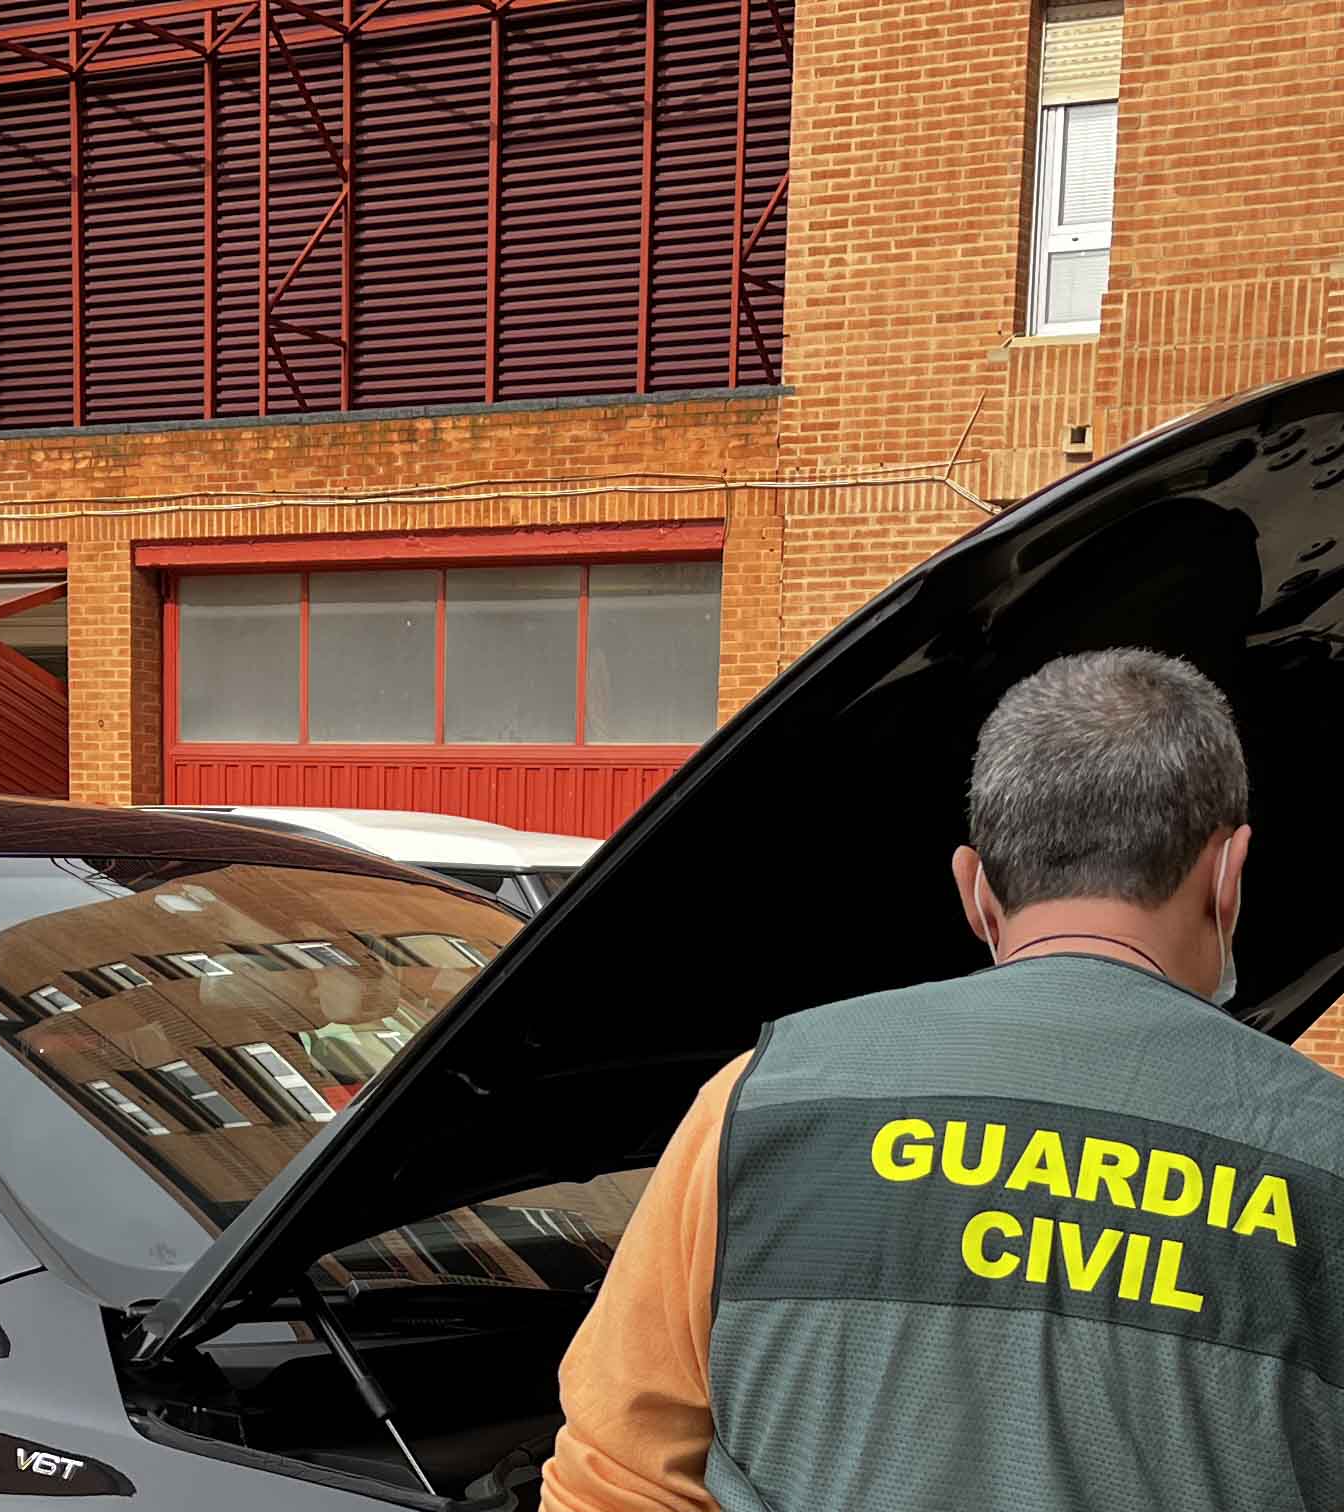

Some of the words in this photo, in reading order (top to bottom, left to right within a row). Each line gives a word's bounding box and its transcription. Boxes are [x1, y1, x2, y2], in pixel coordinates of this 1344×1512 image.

[871, 1118, 1297, 1247] GUARDIA
[961, 1211, 1203, 1312] CIVIL
[16, 1447, 84, 1480] V6T
